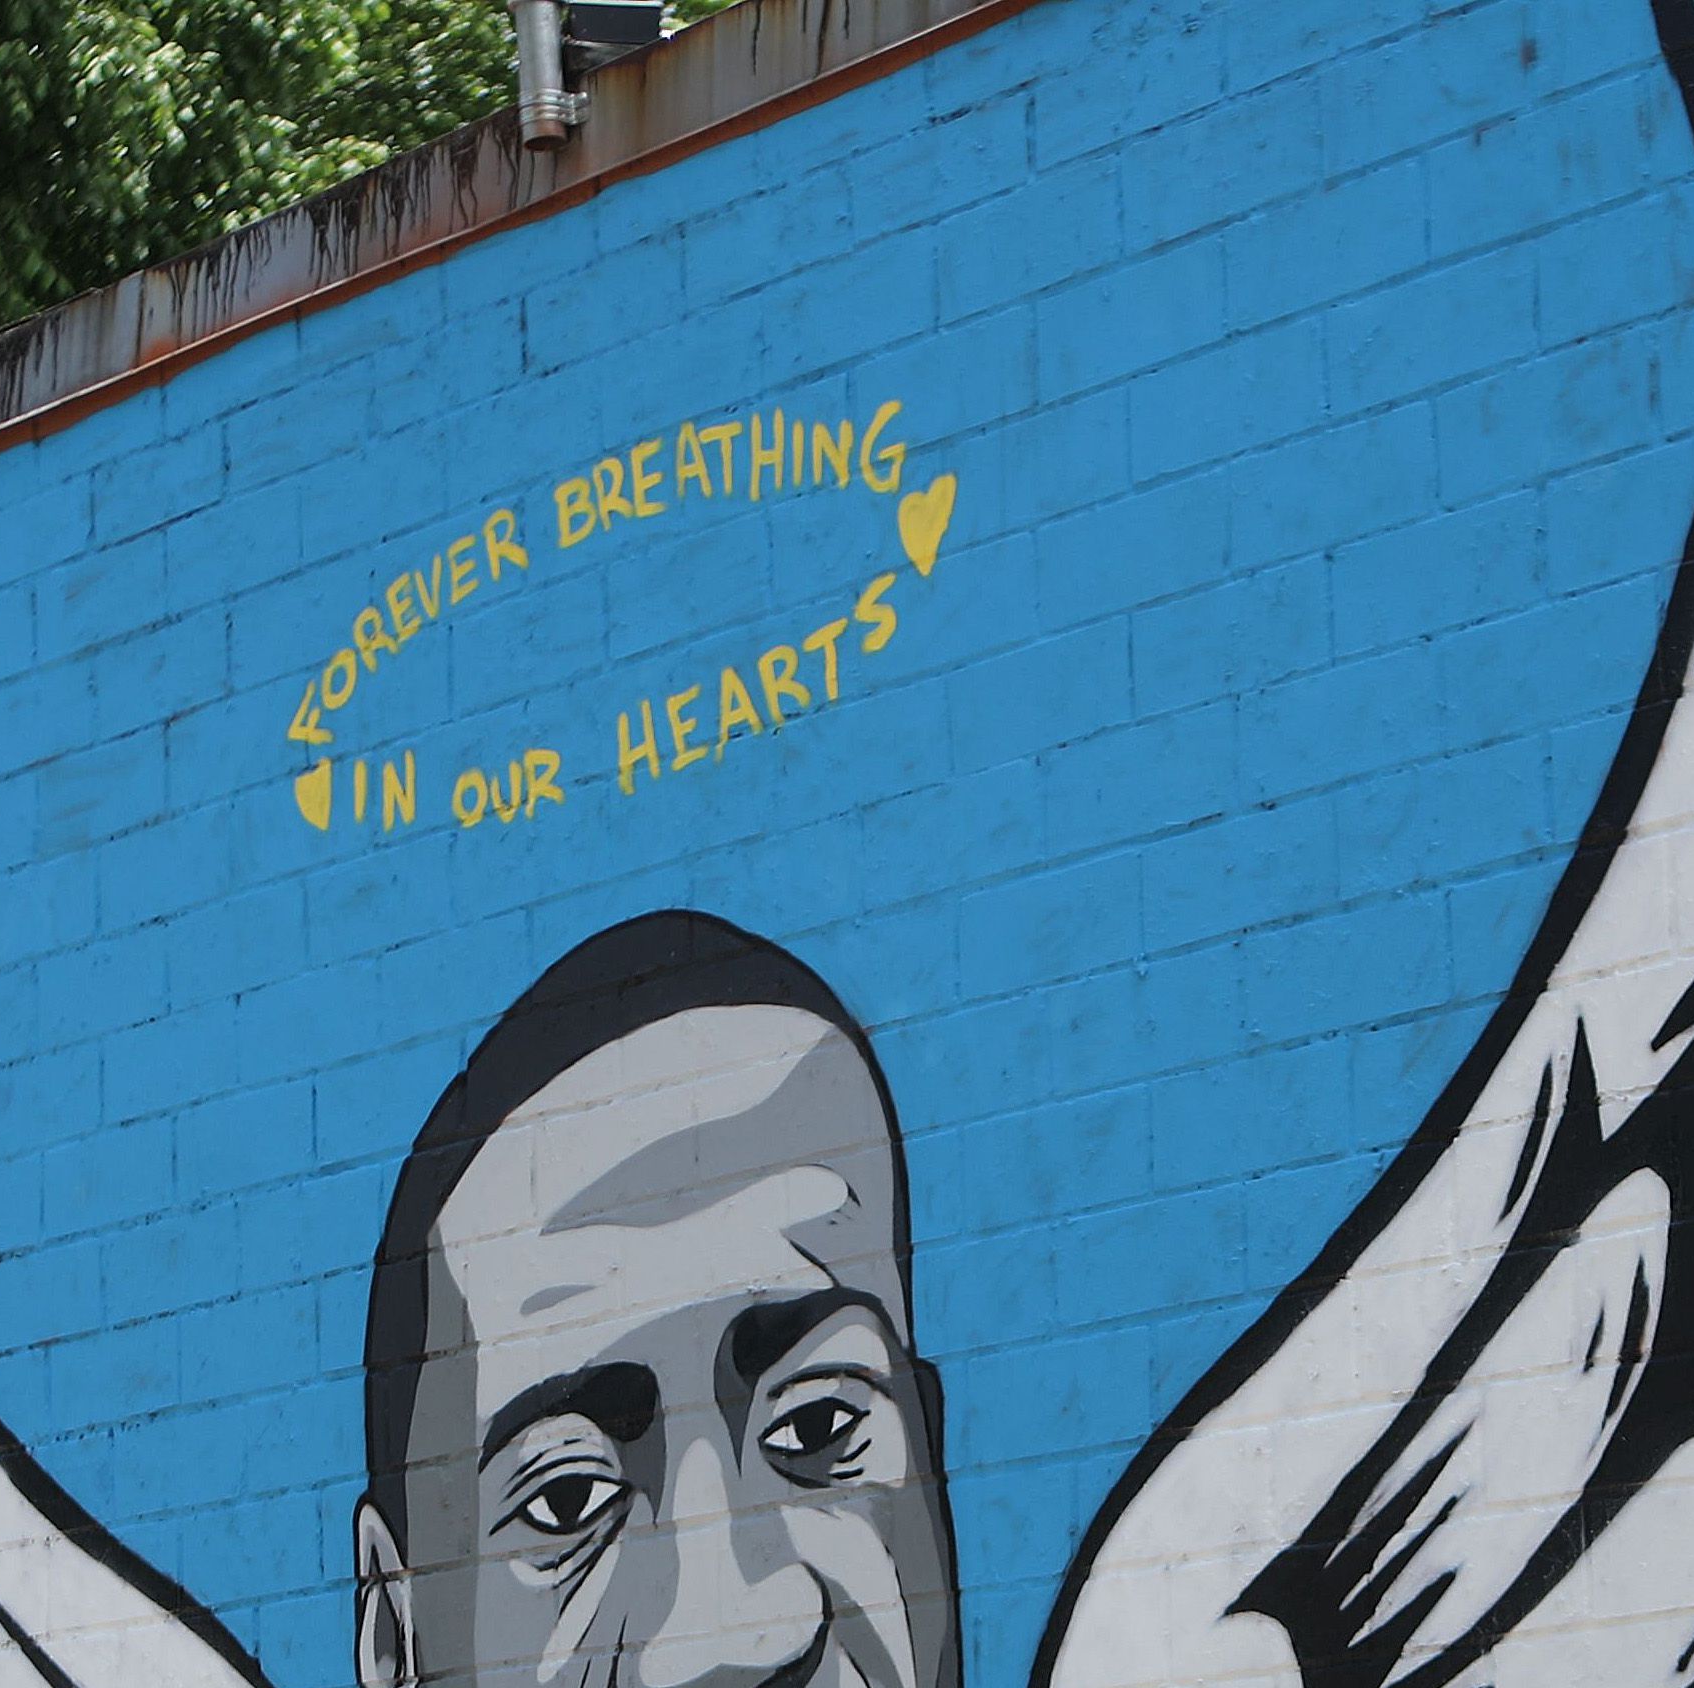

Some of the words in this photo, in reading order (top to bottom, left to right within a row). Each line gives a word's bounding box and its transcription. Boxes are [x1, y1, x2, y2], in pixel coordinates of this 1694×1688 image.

[285, 508, 530, 745] FOREVER
[554, 399, 906, 551] BREATHING
[352, 748, 417, 833] IN
[450, 747, 565, 829] OUR
[616, 571, 899, 797] HEARTS
